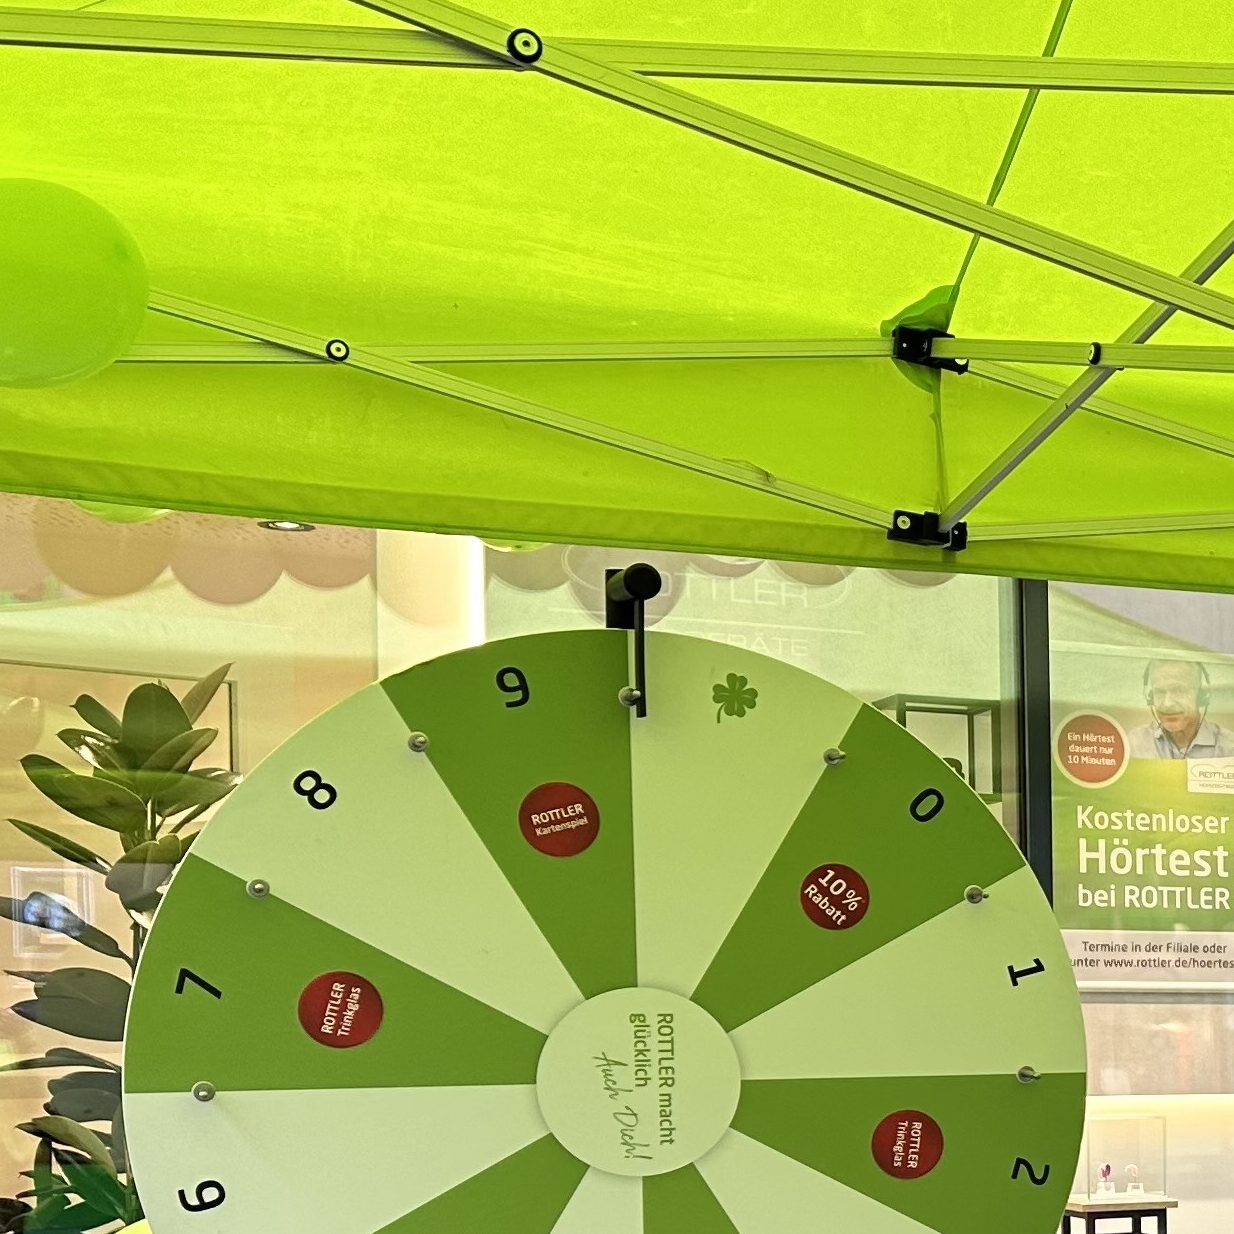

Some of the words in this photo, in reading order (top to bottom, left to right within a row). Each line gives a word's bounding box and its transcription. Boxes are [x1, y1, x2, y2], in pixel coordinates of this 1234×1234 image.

[661, 571, 808, 608] TTLER
[495, 666, 531, 709] 9
[1067, 732, 1081, 742] Ein
[1082, 733, 1116, 744] Hörtest
[1068, 744, 1098, 754] dauert
[1099, 746, 1115, 755] nur
[1067, 754, 1080, 764] 10
[1081, 755, 1117, 766] Minuten
[293, 769, 338, 811] 8
[909, 788, 945, 823] 0
[530, 802, 586, 827] ROTTLER
[535, 815, 589, 839] Kartenspiel
[1076, 805, 1230, 834] Kostenloser
[1078, 837, 1230, 878] Hörtest
[804, 884, 848, 927] Rabatt
[1078, 884, 1116, 908] bei
[1124, 885, 1231, 910] ROTTLER
[1071, 957, 1101, 968] unter
[1082, 941, 1128, 952] Termine
[1131, 941, 1139, 952] in
[1144, 941, 1163, 953] der
[1166, 942, 1200, 953] Filiale
[1202, 943, 1228, 954] oder
[175, 967, 223, 1001] 7
[1007, 957, 1046, 987] 1
[320, 982, 346, 1036] ROTTLER
[337, 985, 362, 1039] Trinkglas
[629, 1013, 652, 1088] glücklich
[657, 1013, 676, 1089] ROTTLER
[592, 1051, 634, 1101] Auch
[612, 1105, 654, 1160] Dich!
[659, 1093, 677, 1146] macht
[893, 1120, 909, 1168] Trinkglas
[906, 1121, 923, 1170] ROTTLER
[1011, 1156, 1051, 1186] 2
